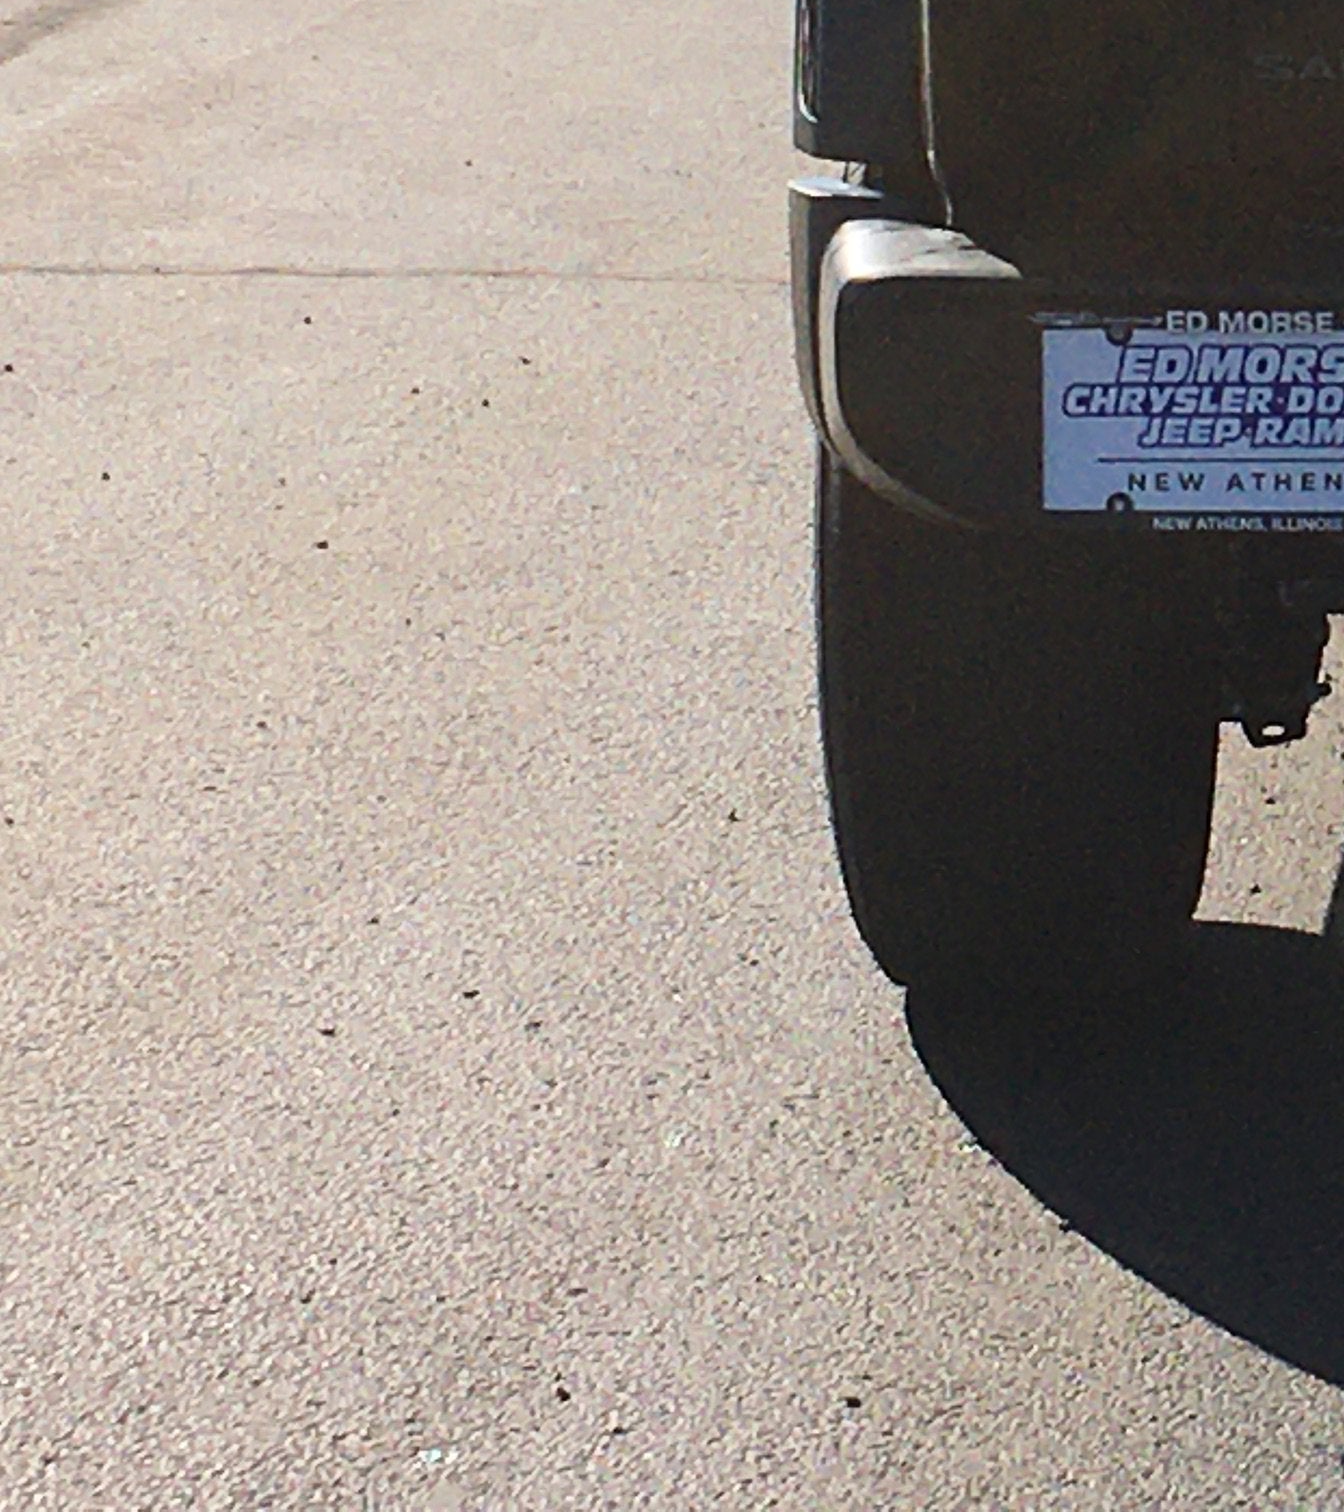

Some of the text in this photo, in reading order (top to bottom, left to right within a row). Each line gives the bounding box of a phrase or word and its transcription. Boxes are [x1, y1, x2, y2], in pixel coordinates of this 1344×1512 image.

[1166, 309, 1208, 334] ED
[1218, 309, 1334, 335] MORSE
[1116, 343, 1194, 384] ED
[1062, 384, 1278, 418] CHRYSLER
[1138, 416, 1246, 449] JEEP
[1128, 472, 1206, 492] NEW
[1152, 517, 1192, 531] NEW
